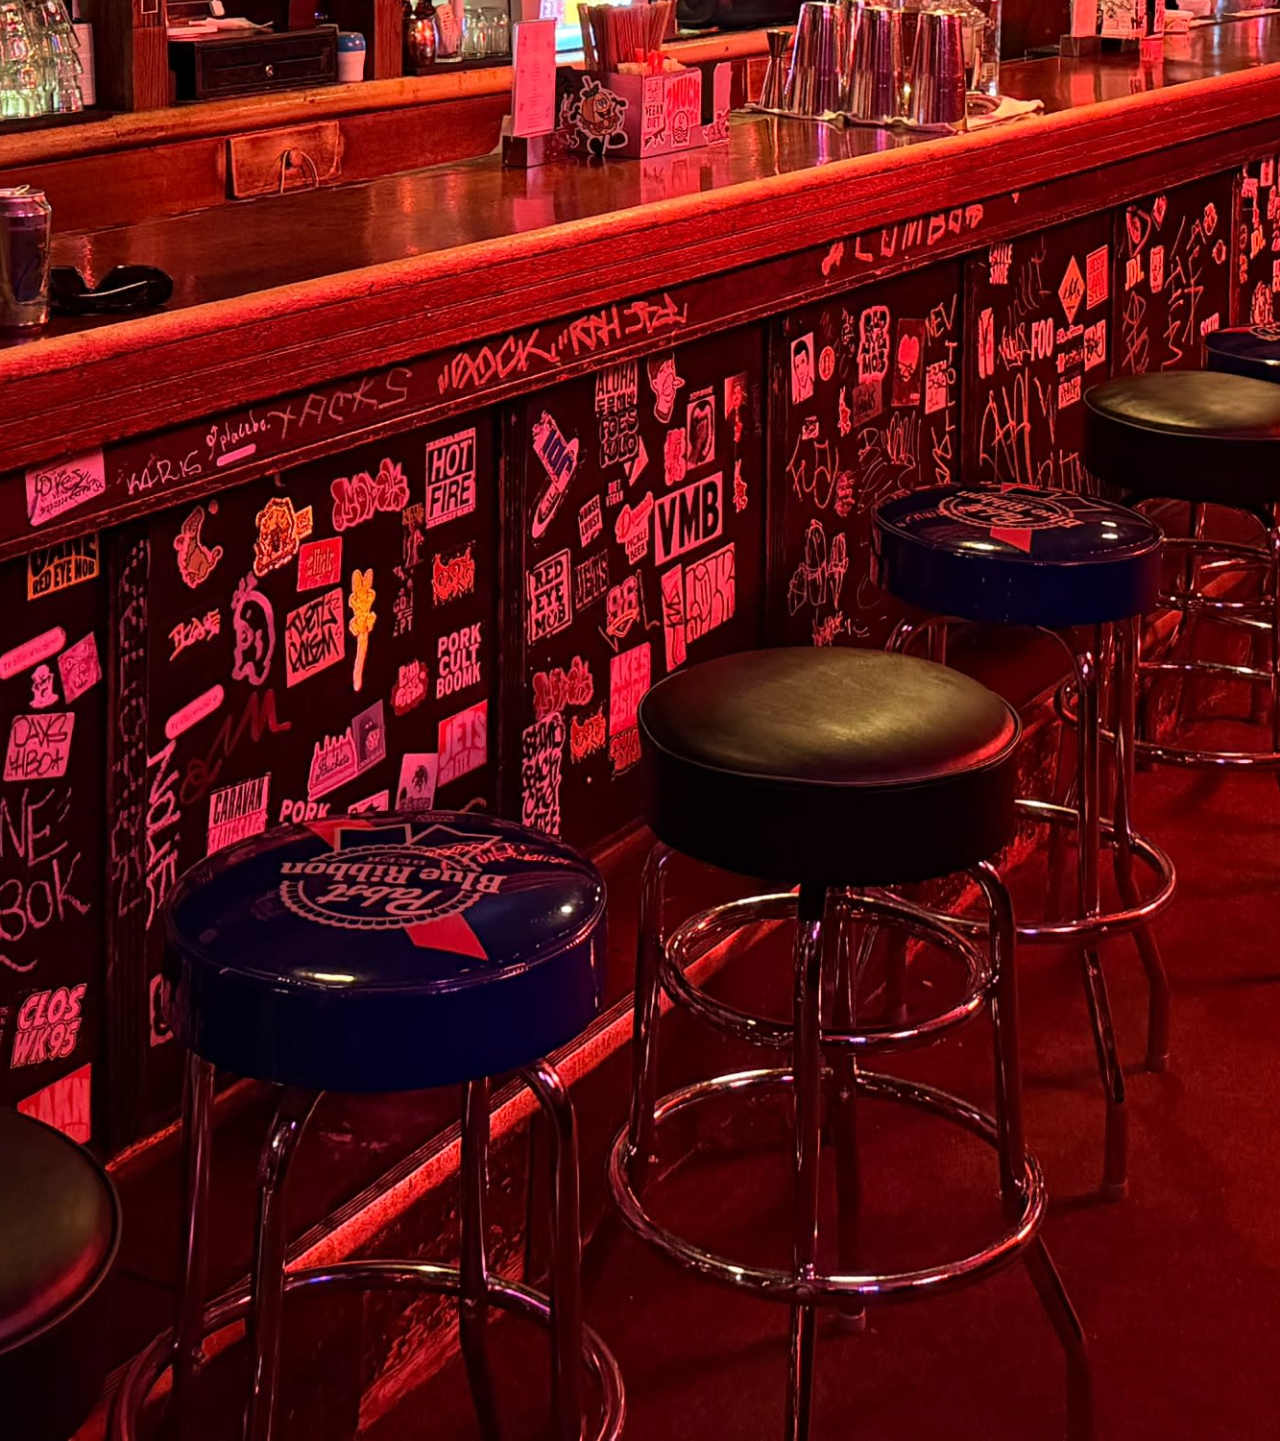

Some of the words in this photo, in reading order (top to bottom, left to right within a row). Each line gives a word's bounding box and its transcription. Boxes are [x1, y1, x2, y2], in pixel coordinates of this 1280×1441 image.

[431, 439, 473, 483] HOT
[429, 477, 471, 519] FIRE
[655, 480, 720, 560] VMB
[32, 570, 52, 596] RED
[53, 560, 73, 588] EYE
[74, 558, 96, 581] MOB
[534, 561, 564, 591] RED
[437, 623, 482, 658] PORK
[439, 646, 479, 677] CULT
[279, 799, 332, 824] PORK
[279, 861, 407, 886] Ribbon
[419, 867, 508, 895] Blue
[317, 882, 441, 917] Pabst
